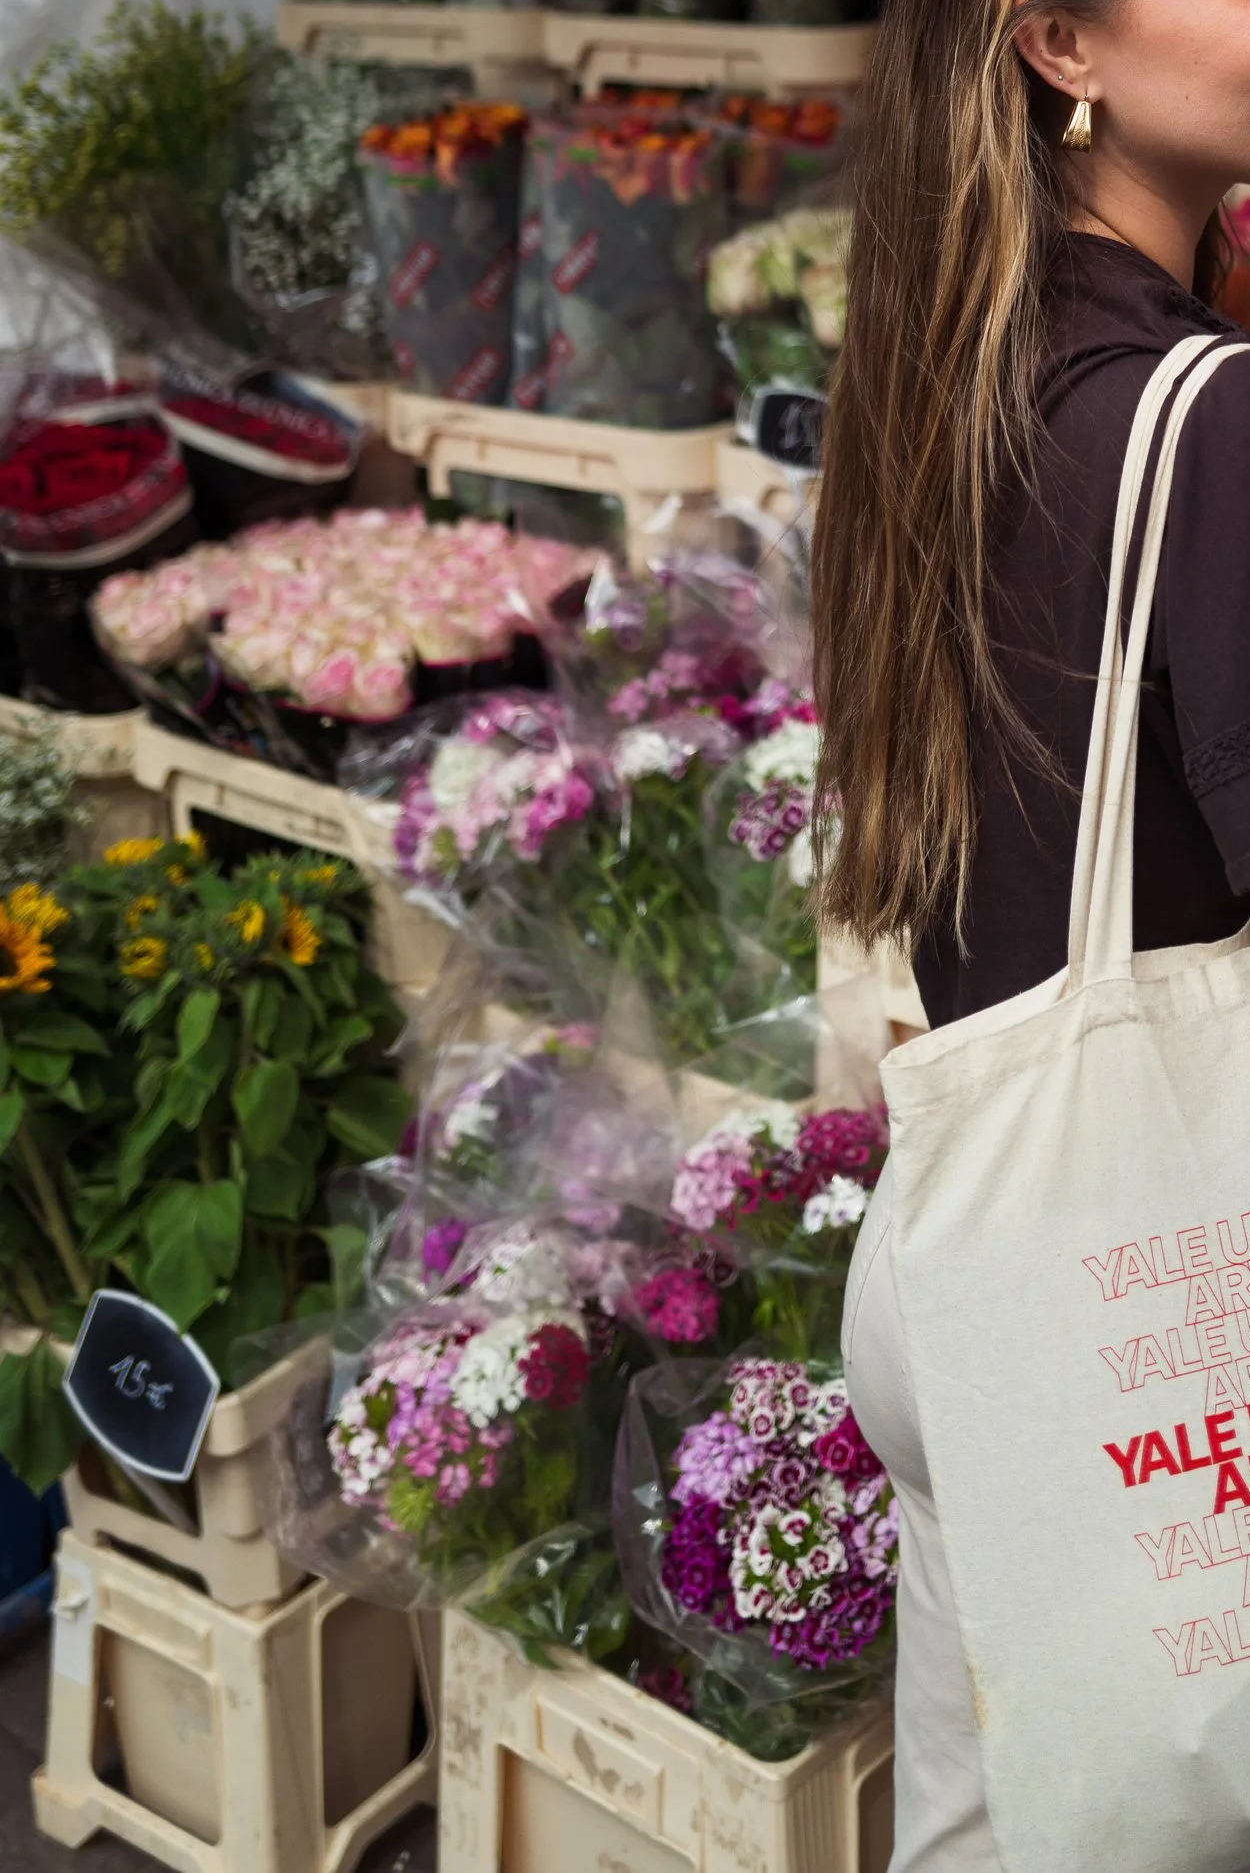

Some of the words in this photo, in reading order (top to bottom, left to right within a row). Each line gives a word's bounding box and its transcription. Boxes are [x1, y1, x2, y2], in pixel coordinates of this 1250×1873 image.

[1082, 1225, 1214, 1302] YALE
[1098, 1316, 1237, 1393] YALE
[1103, 1411, 1243, 1488] YALE
